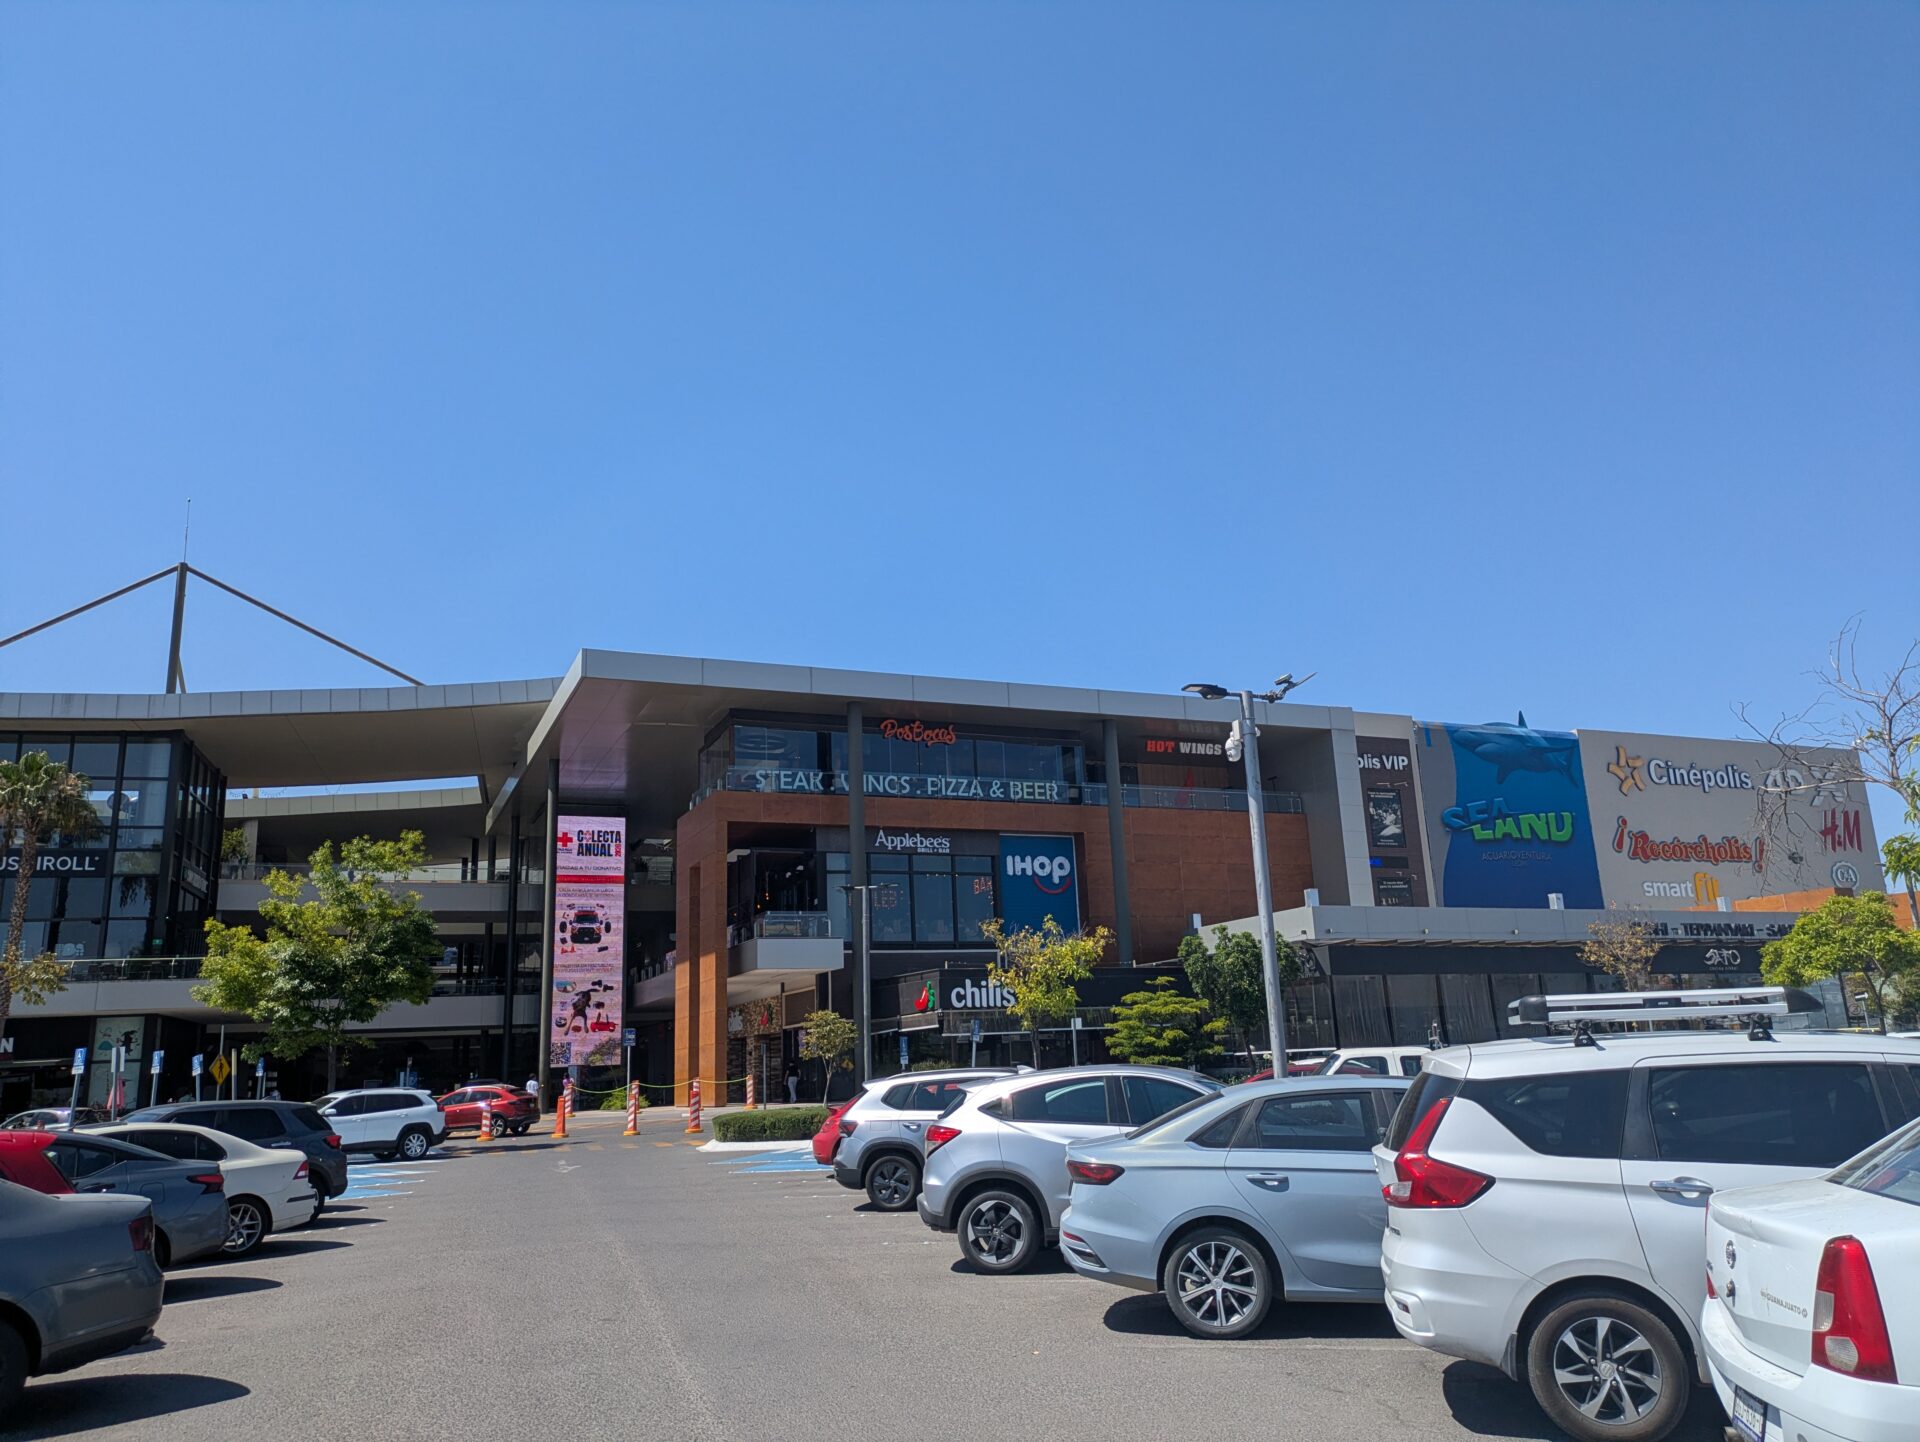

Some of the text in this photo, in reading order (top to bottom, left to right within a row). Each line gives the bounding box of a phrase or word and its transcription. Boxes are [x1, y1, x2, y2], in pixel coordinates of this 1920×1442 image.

[1146, 740, 1222, 755] HOT WINGS
[1382, 755, 1409, 770] VIP
[1648, 759, 1752, 793] Cinépolis
[755, 770, 824, 791] STEAK
[927, 777, 984, 797] PIZZA
[990, 780, 1004, 797] &
[1010, 781, 1059, 800] BEER
[577, 830, 621, 843] COLECTA
[1819, 808, 1863, 853] H&M
[577, 843, 613, 857] ANUAL
[1643, 880, 1695, 897] smart
